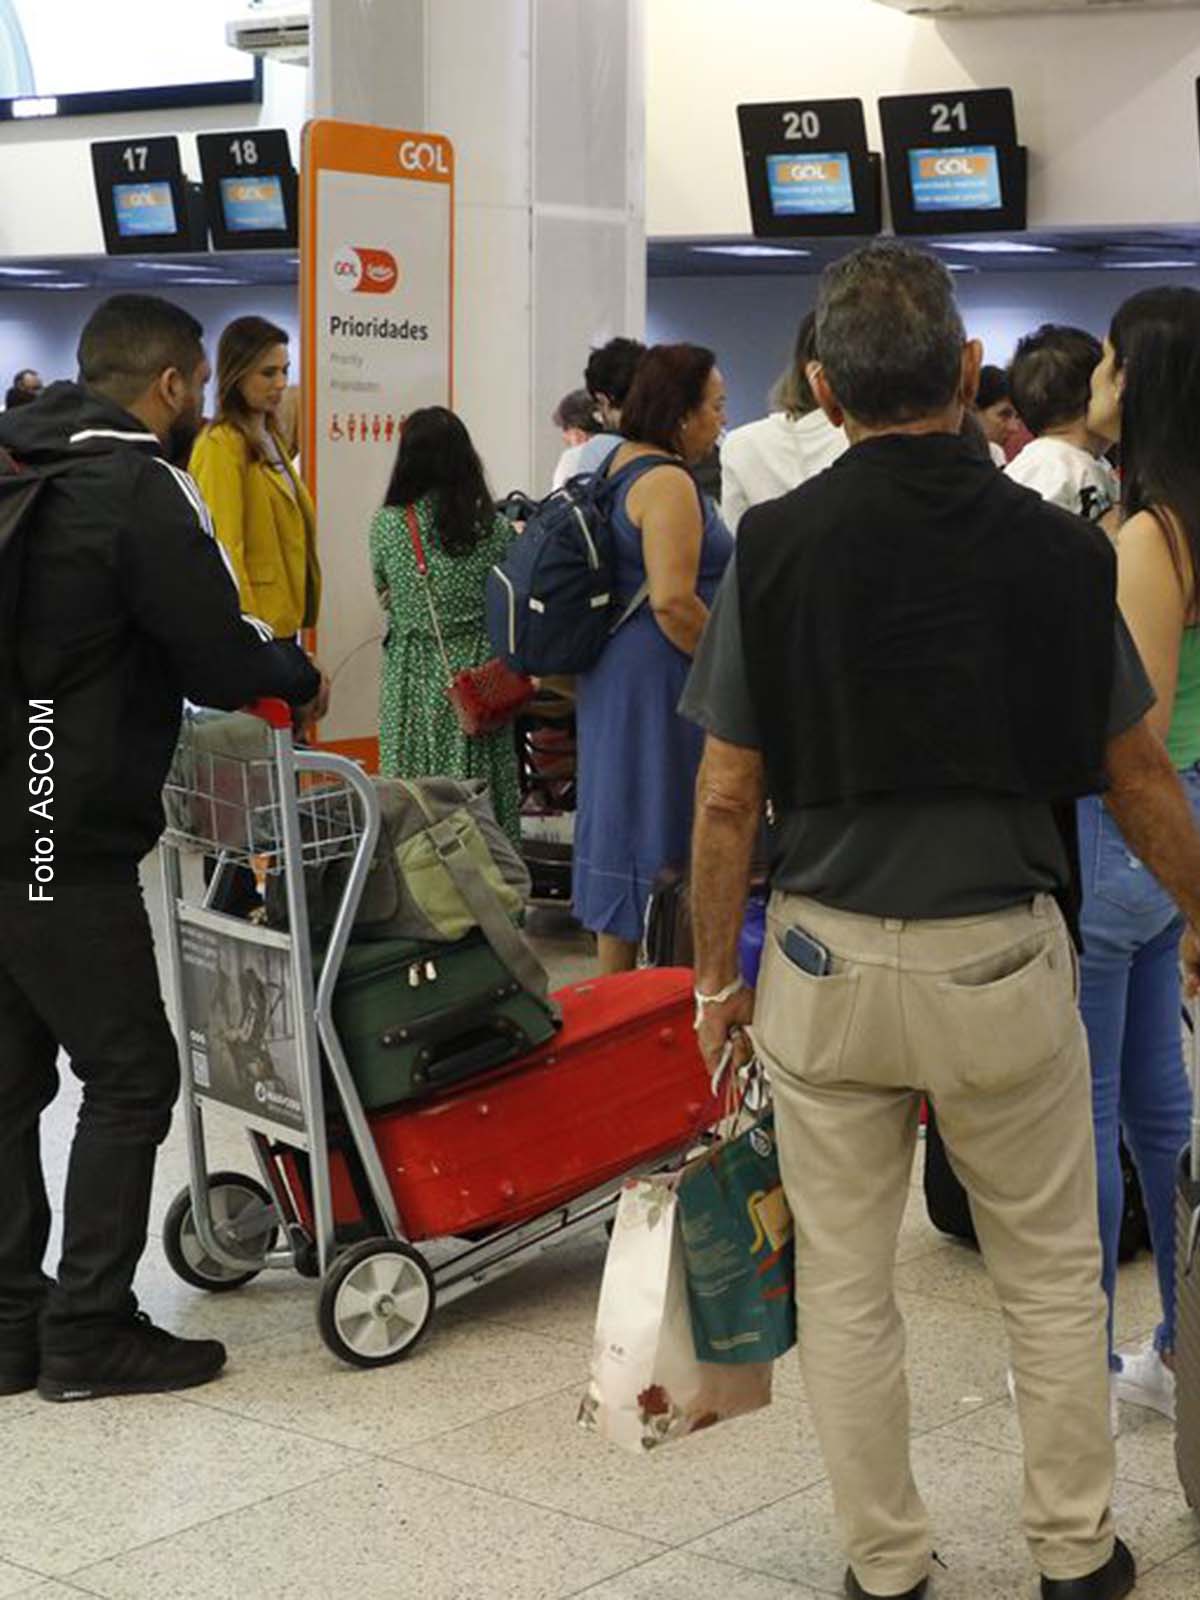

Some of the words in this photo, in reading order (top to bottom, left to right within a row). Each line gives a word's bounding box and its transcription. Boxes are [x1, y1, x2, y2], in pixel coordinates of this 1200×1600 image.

[782, 110, 820, 139] 20
[930, 101, 968, 133] 21
[123, 147, 148, 171] 17
[230, 139, 258, 165] 18
[400, 141, 448, 173] GOL
[791, 164, 827, 179] GOL
[934, 158, 974, 175] GOL
[330, 315, 428, 341] Prioridades
